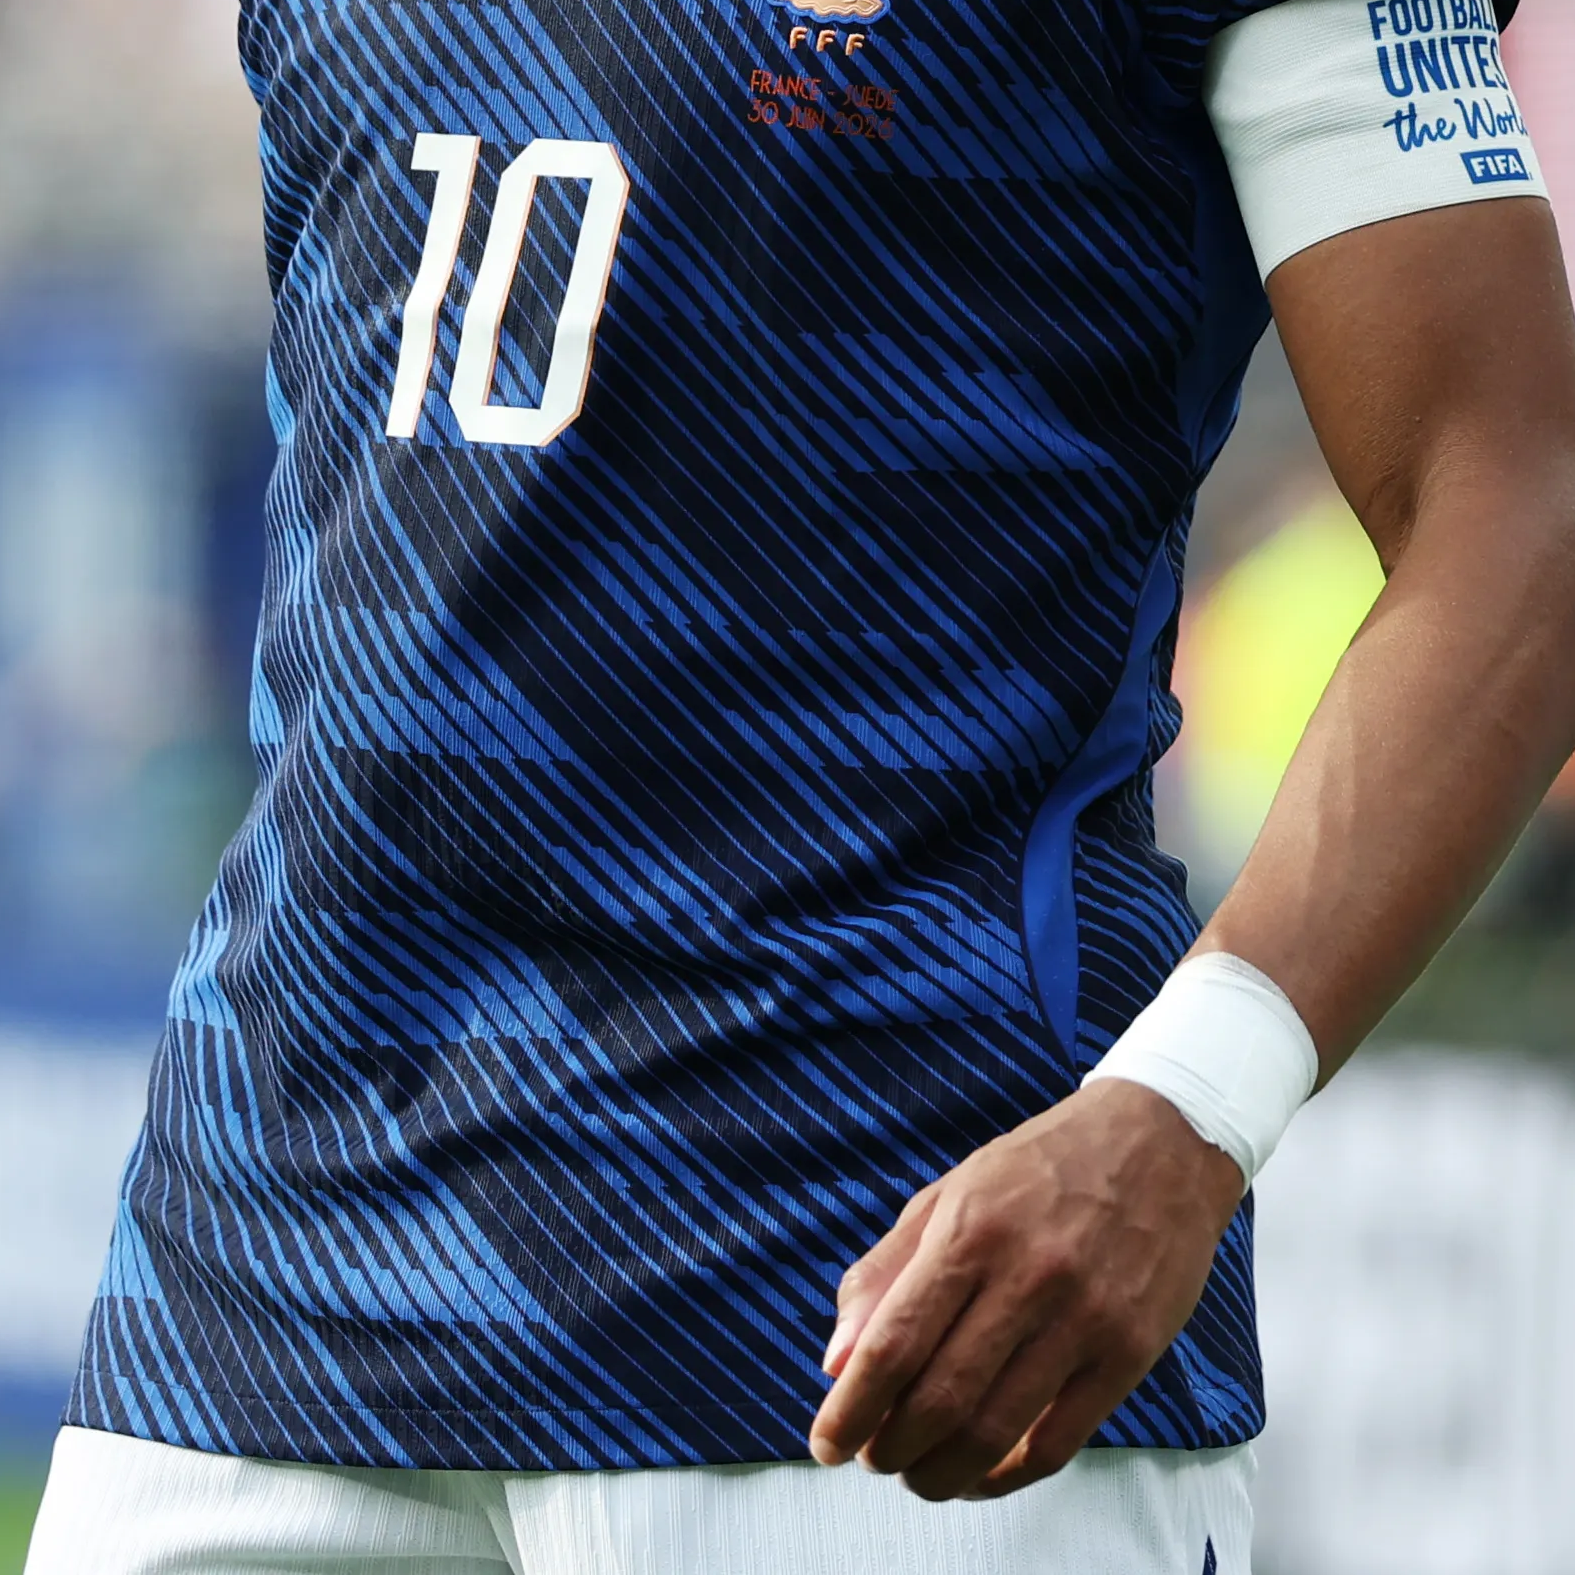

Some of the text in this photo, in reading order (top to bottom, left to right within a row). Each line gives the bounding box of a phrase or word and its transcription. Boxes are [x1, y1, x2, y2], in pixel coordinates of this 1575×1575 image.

[789, 26, 865, 56] FFF
[750, 69, 822, 101] FRANCE
[1377, 36, 1508, 98] UNITES
[747, 98, 893, 140] 30 JUIN 2026
[1383, 102, 1457, 152] the
[1470, 154, 1524, 177] FIFA
[385, 132, 631, 447] 10
